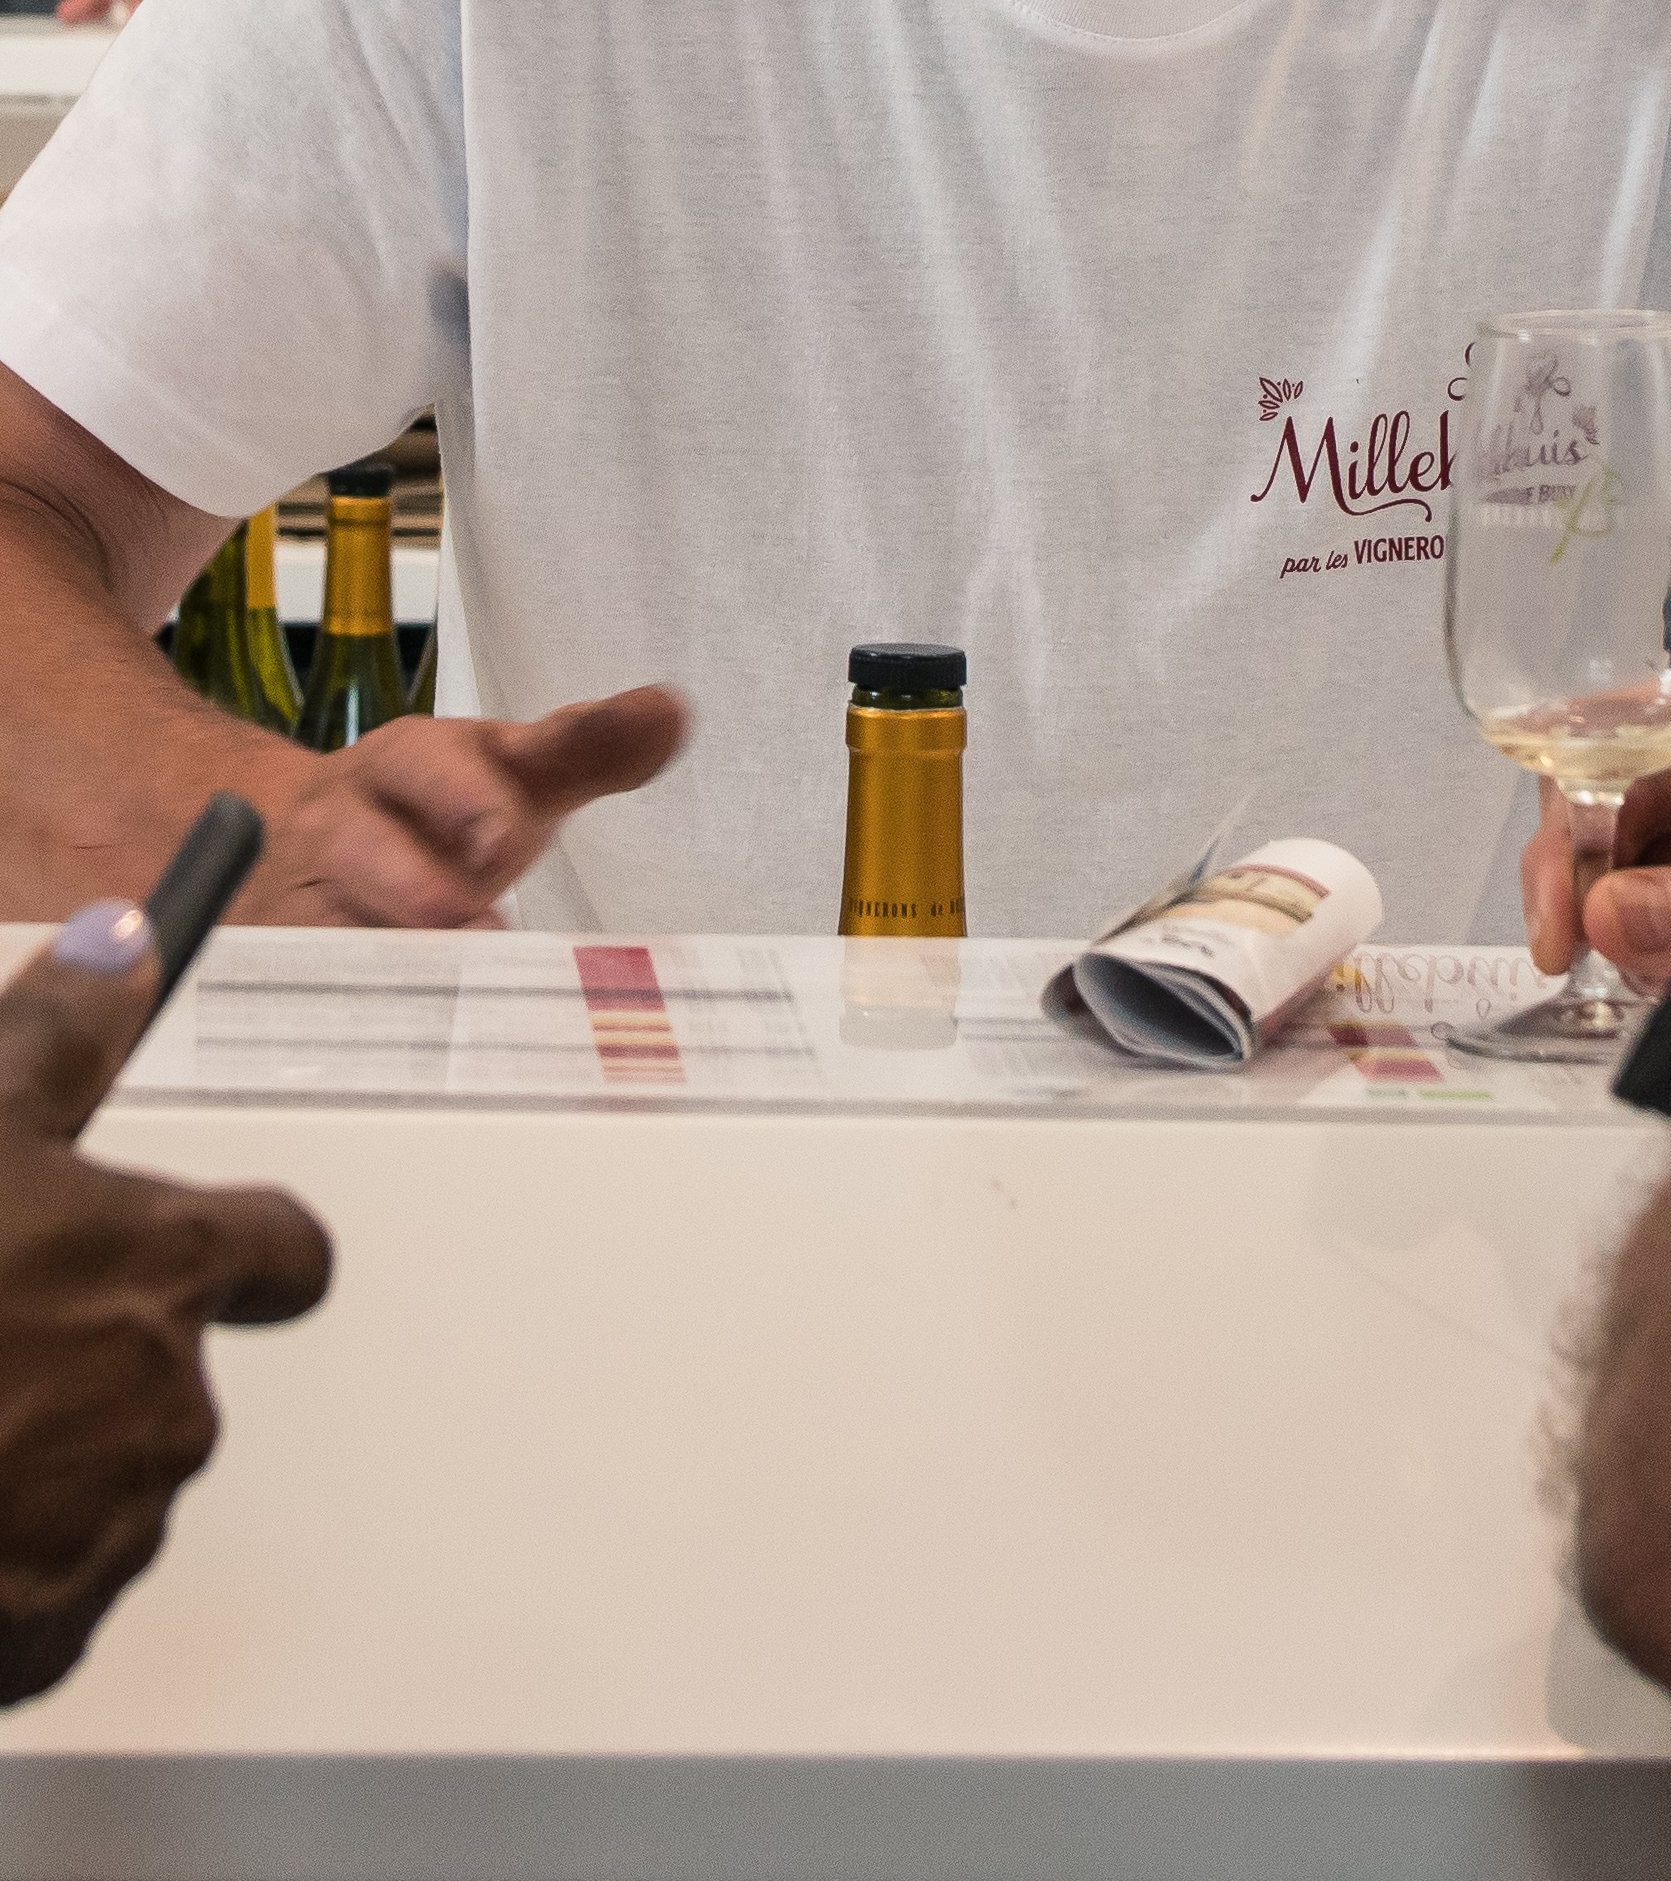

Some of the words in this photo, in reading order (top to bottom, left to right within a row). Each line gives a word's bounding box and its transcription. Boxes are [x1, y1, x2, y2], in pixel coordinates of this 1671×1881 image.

[1279, 557, 1321, 579] par
[1326, 549, 1349, 570] les
[1353, 533, 1445, 565] VIGNERO
